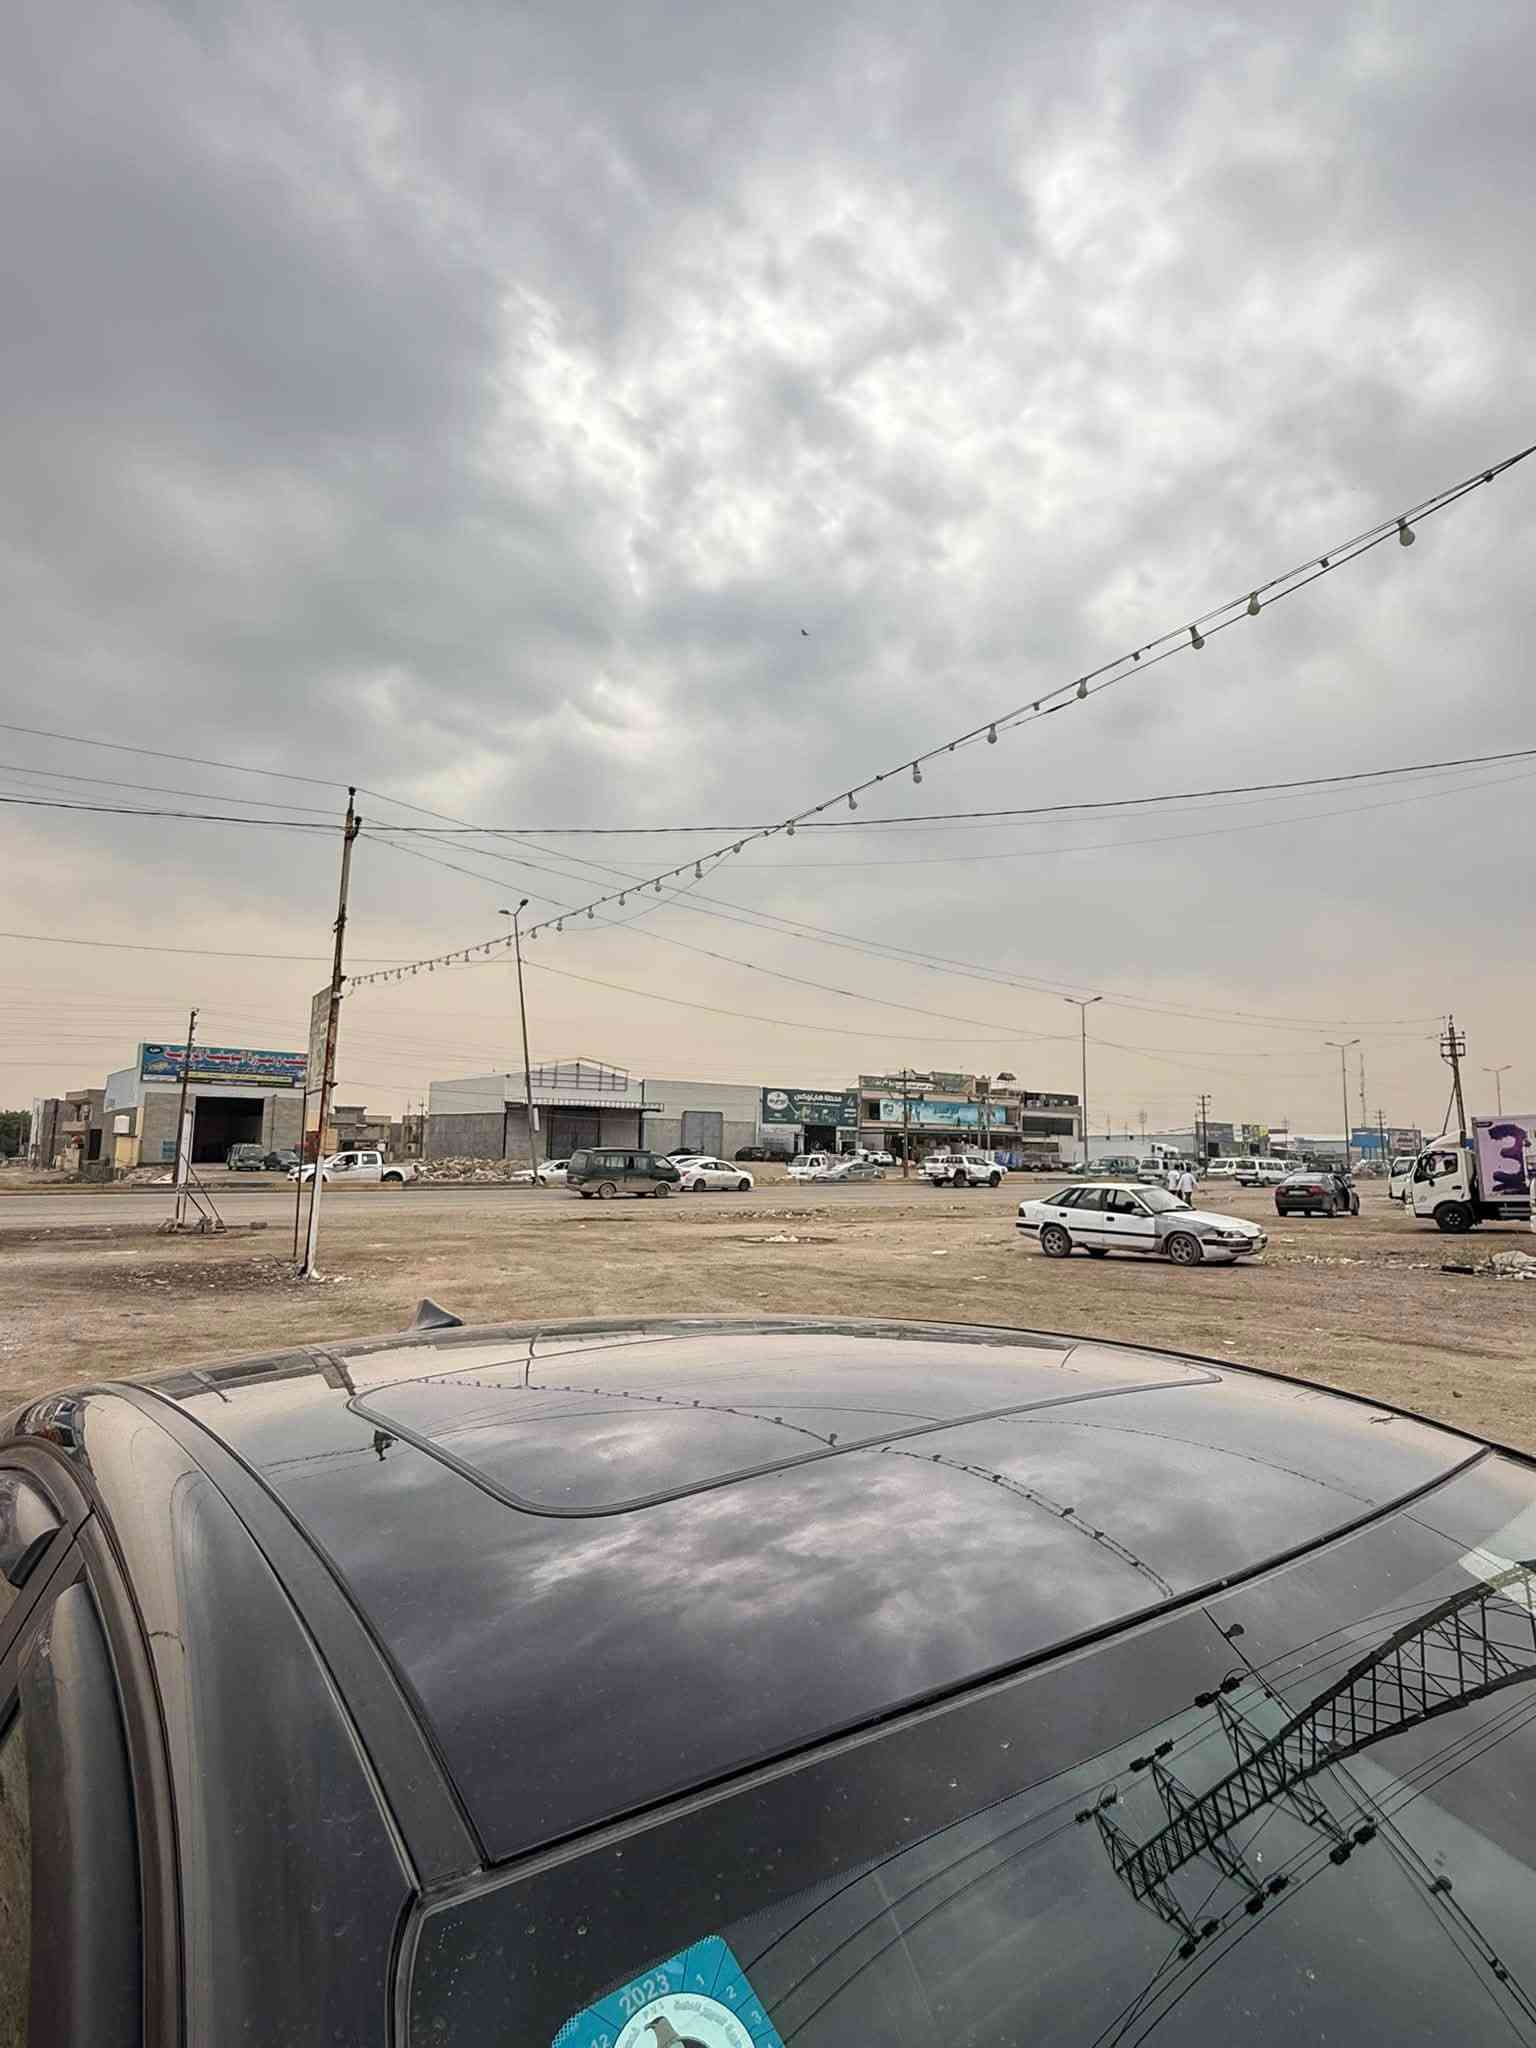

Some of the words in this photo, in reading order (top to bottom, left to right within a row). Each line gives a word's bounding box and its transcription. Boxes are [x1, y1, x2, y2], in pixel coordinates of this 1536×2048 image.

[695, 1973, 705, 1986] 1
[618, 1973, 670, 2016] 2023
[725, 1984, 737, 1999] 2
[750, 2010, 763, 2025] 3
